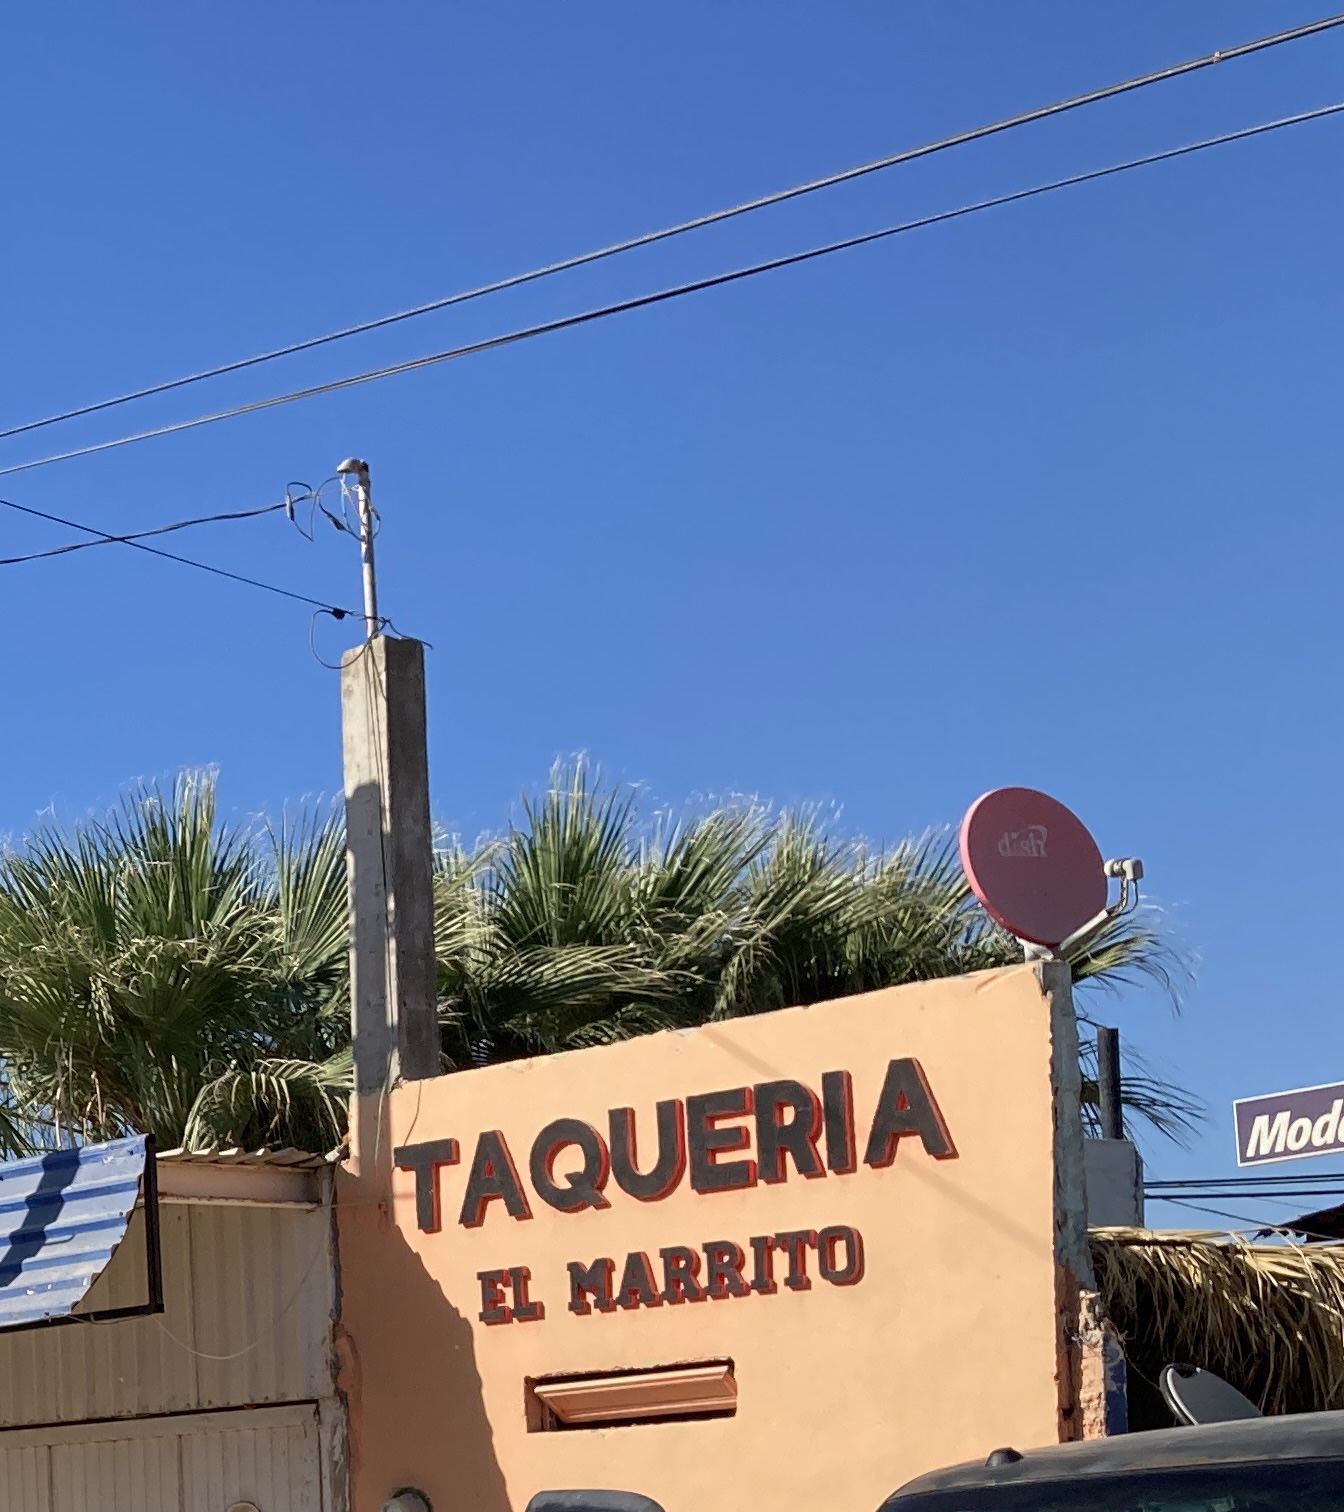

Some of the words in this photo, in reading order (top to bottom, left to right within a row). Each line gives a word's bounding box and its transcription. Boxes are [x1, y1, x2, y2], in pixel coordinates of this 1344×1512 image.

[393, 1057, 959, 1234] TAQUERIA
[1246, 1099, 1344, 1157] Mod
[477, 1266, 545, 1326] EL
[567, 1225, 865, 1316] MARRITO
